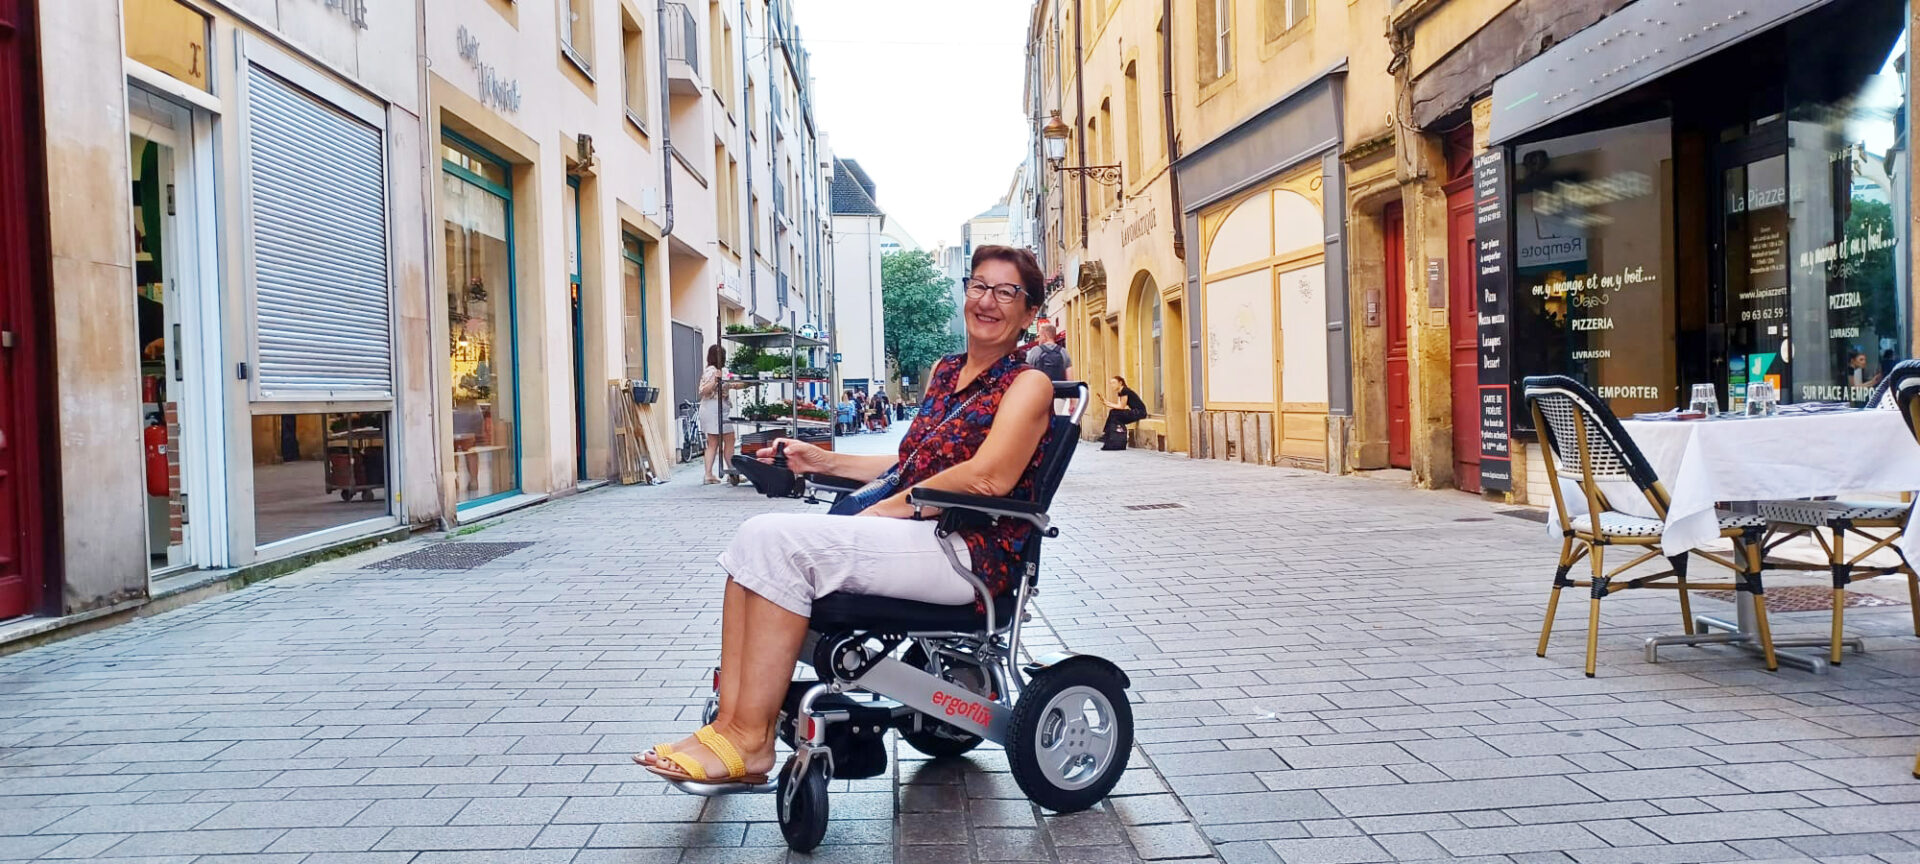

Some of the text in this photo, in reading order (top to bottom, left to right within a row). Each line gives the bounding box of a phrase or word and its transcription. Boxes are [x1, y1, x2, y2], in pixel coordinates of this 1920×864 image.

[1732, 193, 1745, 213] La
[1121, 207, 1156, 248] LAVOMATIQUE
[1839, 234, 1848, 259] et
[1553, 279, 1584, 297] mange
[1586, 273, 1598, 290] et
[1601, 278, 1614, 289] on
[1614, 275, 1622, 292] y
[1829, 292, 1861, 310] PIZZERIA
[1741, 310, 1751, 321] 09
[1752, 309, 1762, 320] 63
[1763, 308, 1773, 319] 62
[1774, 307, 1784, 318] 59
[1572, 317, 1614, 331] PIZZERIA
[1830, 328, 1859, 339] LIVRAISON
[1572, 350, 1611, 360] LIVRAISON
[1598, 386, 1659, 399] EMPORTER
[1802, 385, 1816, 400] SUR
[1818, 385, 1842, 401] PLACE
[1843, 386, 1850, 401] A
[932, 690, 994, 728] ergoflix
